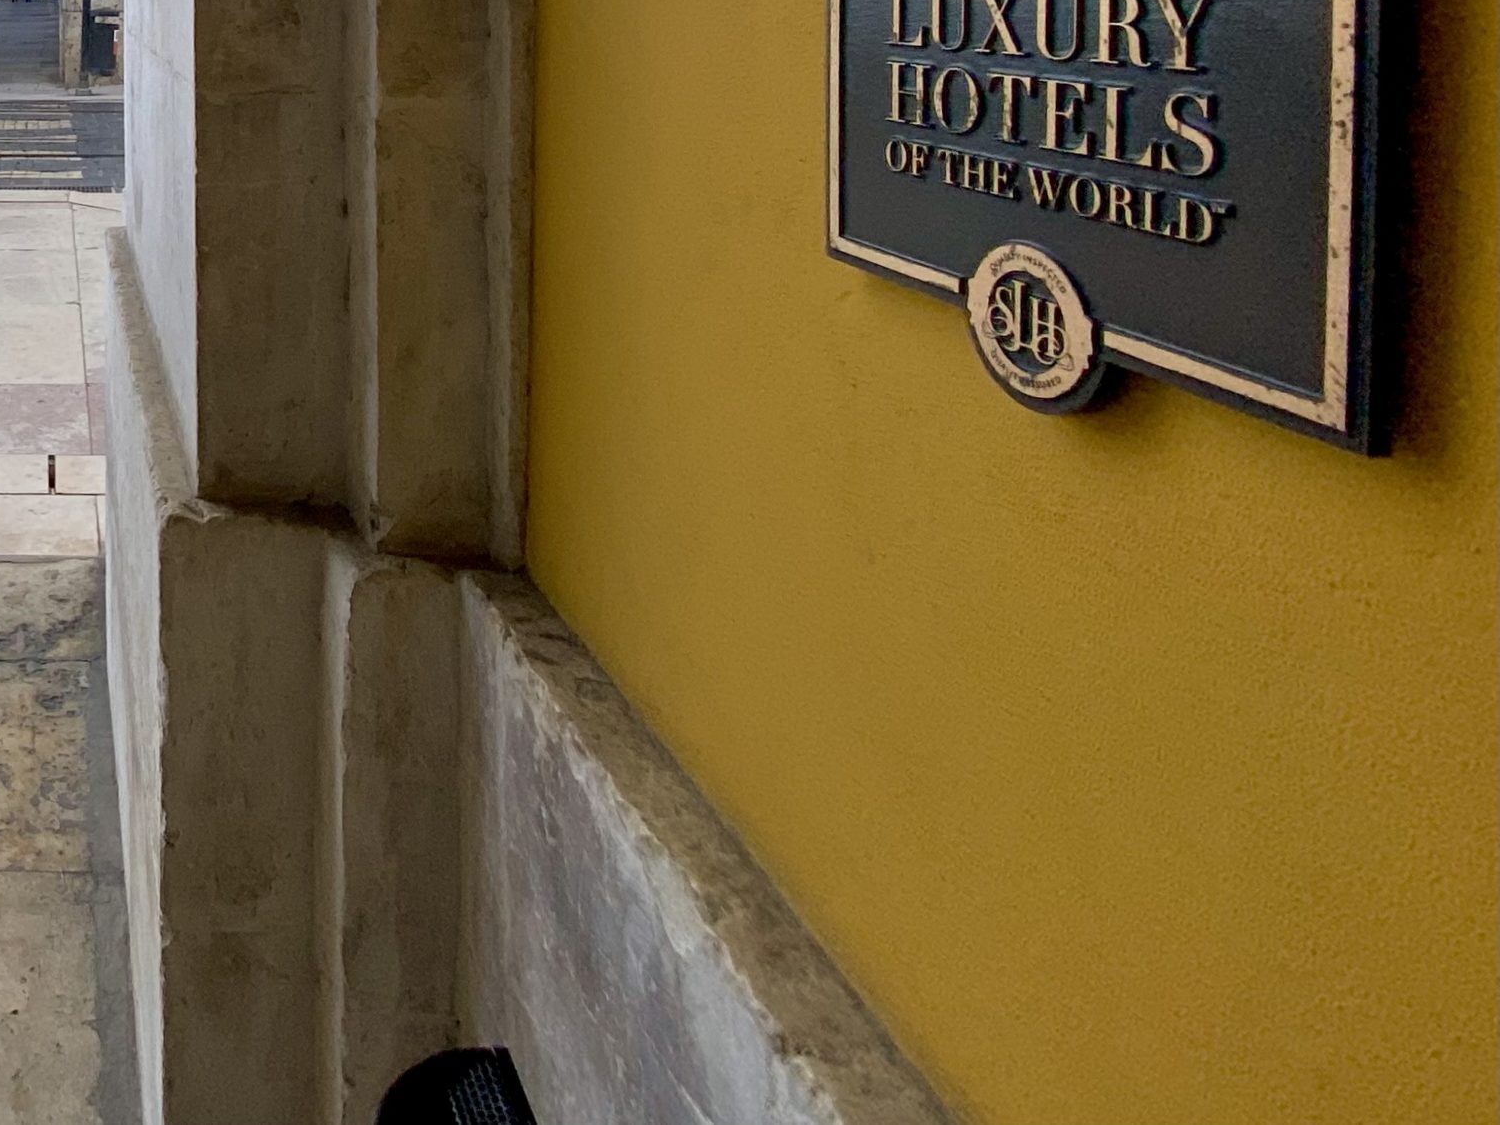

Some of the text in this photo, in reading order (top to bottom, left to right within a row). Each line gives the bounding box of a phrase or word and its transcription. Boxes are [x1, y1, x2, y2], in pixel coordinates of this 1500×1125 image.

[885, 61, 1217, 177] HOTELS
[885, 139, 929, 177] OF
[937, 149, 1015, 199] THE
[988, 279, 1066, 365] SLH
